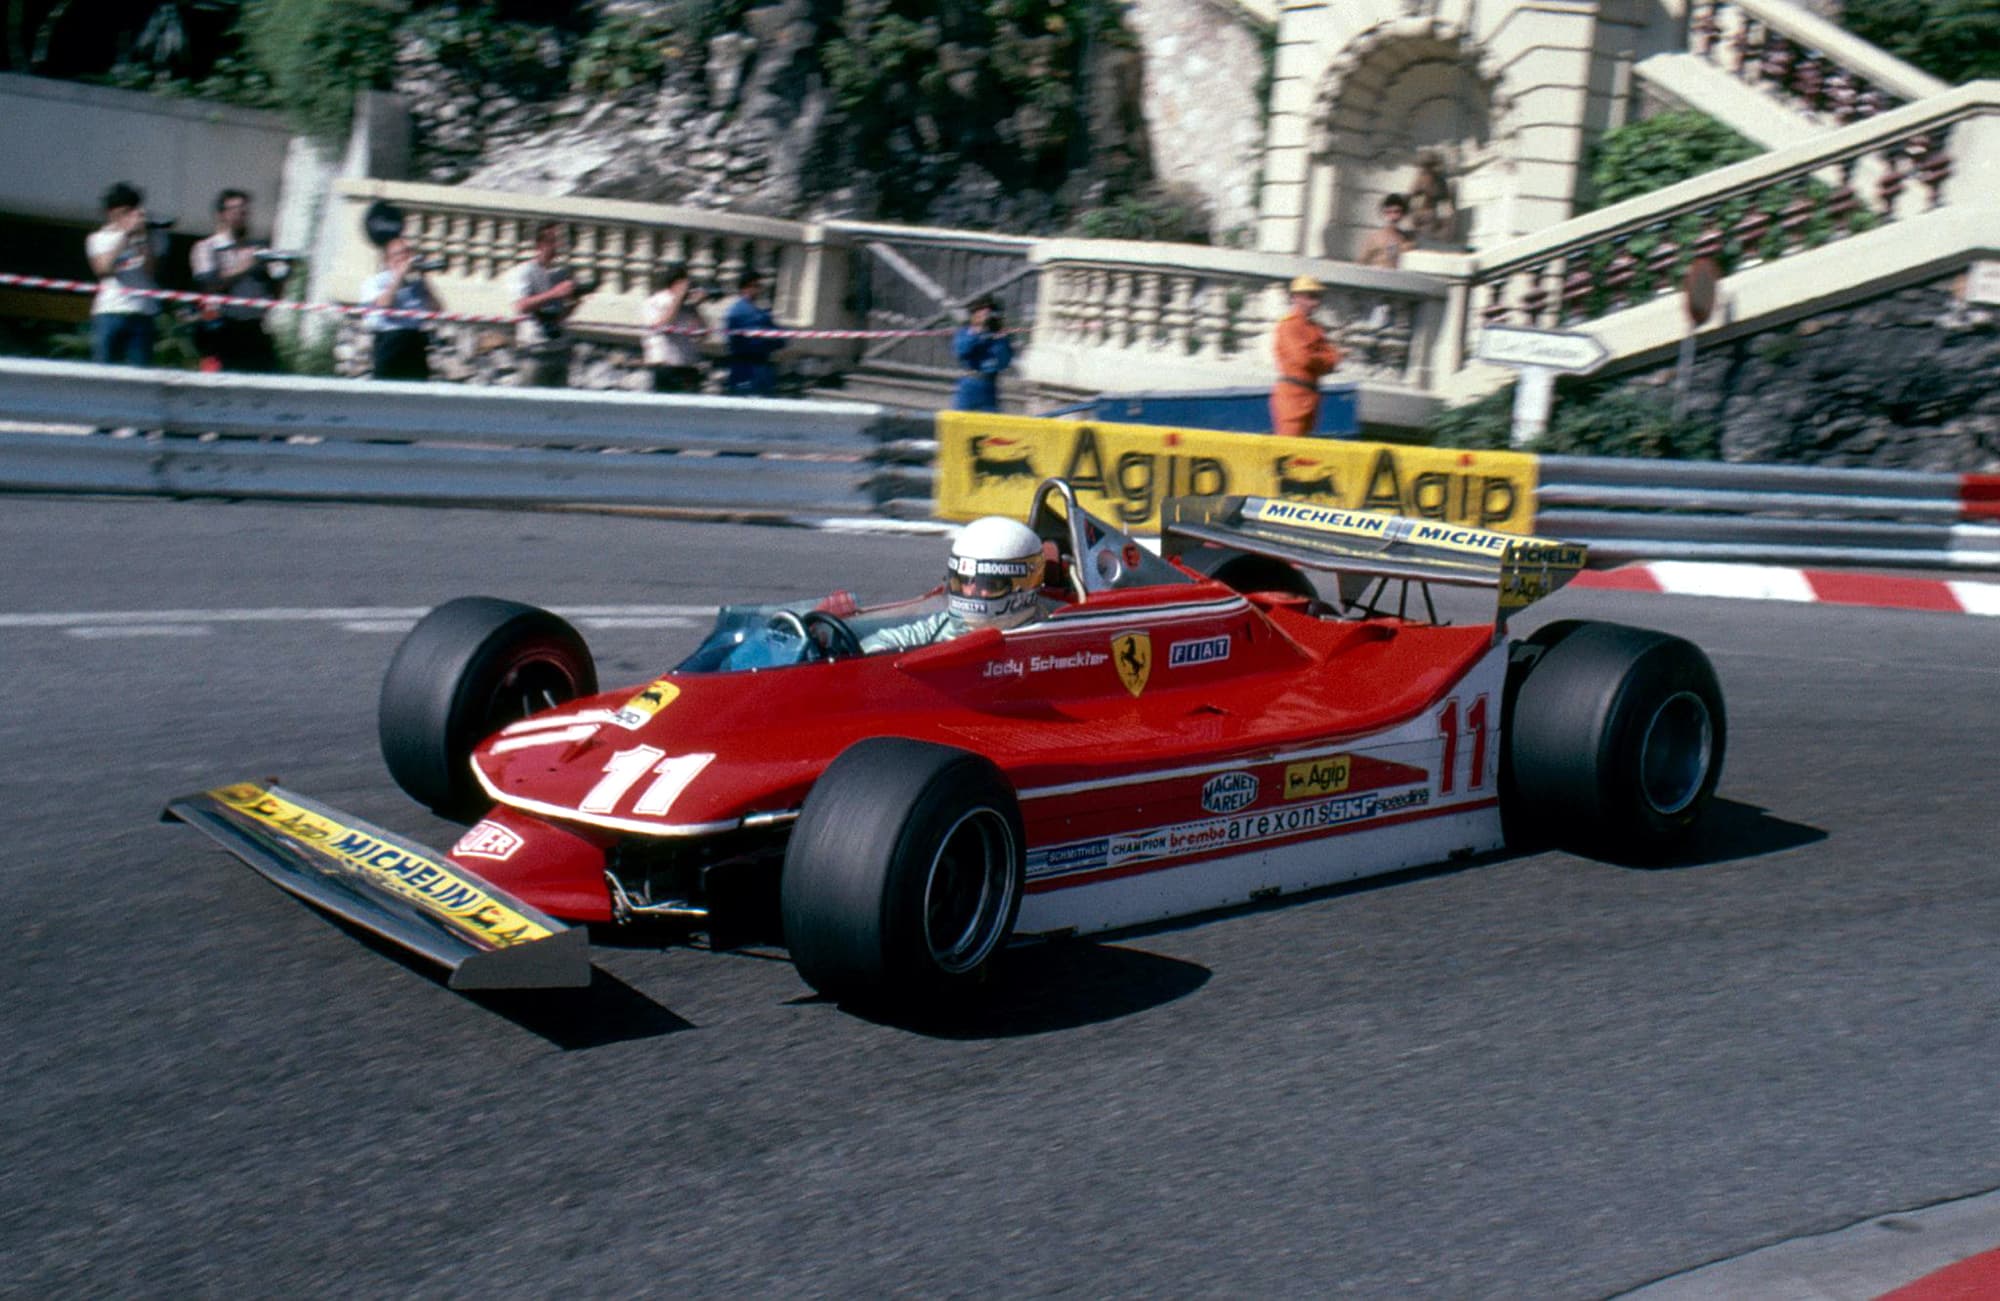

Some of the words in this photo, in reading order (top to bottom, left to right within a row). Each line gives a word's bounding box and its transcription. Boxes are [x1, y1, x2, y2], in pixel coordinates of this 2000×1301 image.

[1066, 427, 1227, 523] Agip
[1363, 449, 1518, 526] Agip
[1267, 504, 1384, 531] MICHELIN
[977, 562, 1026, 576] BROOKLYN
[1175, 640, 1226, 662] FIAT
[983, 659, 1024, 677] Jody
[1436, 693, 1489, 797] 11
[578, 743, 717, 816] 11
[1307, 761, 1347, 790] Agip
[1228, 804, 1329, 841] arexons
[1329, 796, 1377, 821] SKF
[1111, 836, 1166, 856] CHAMPION
[1170, 828, 1226, 847] brembo
[330, 833, 479, 908] MICHELIN
